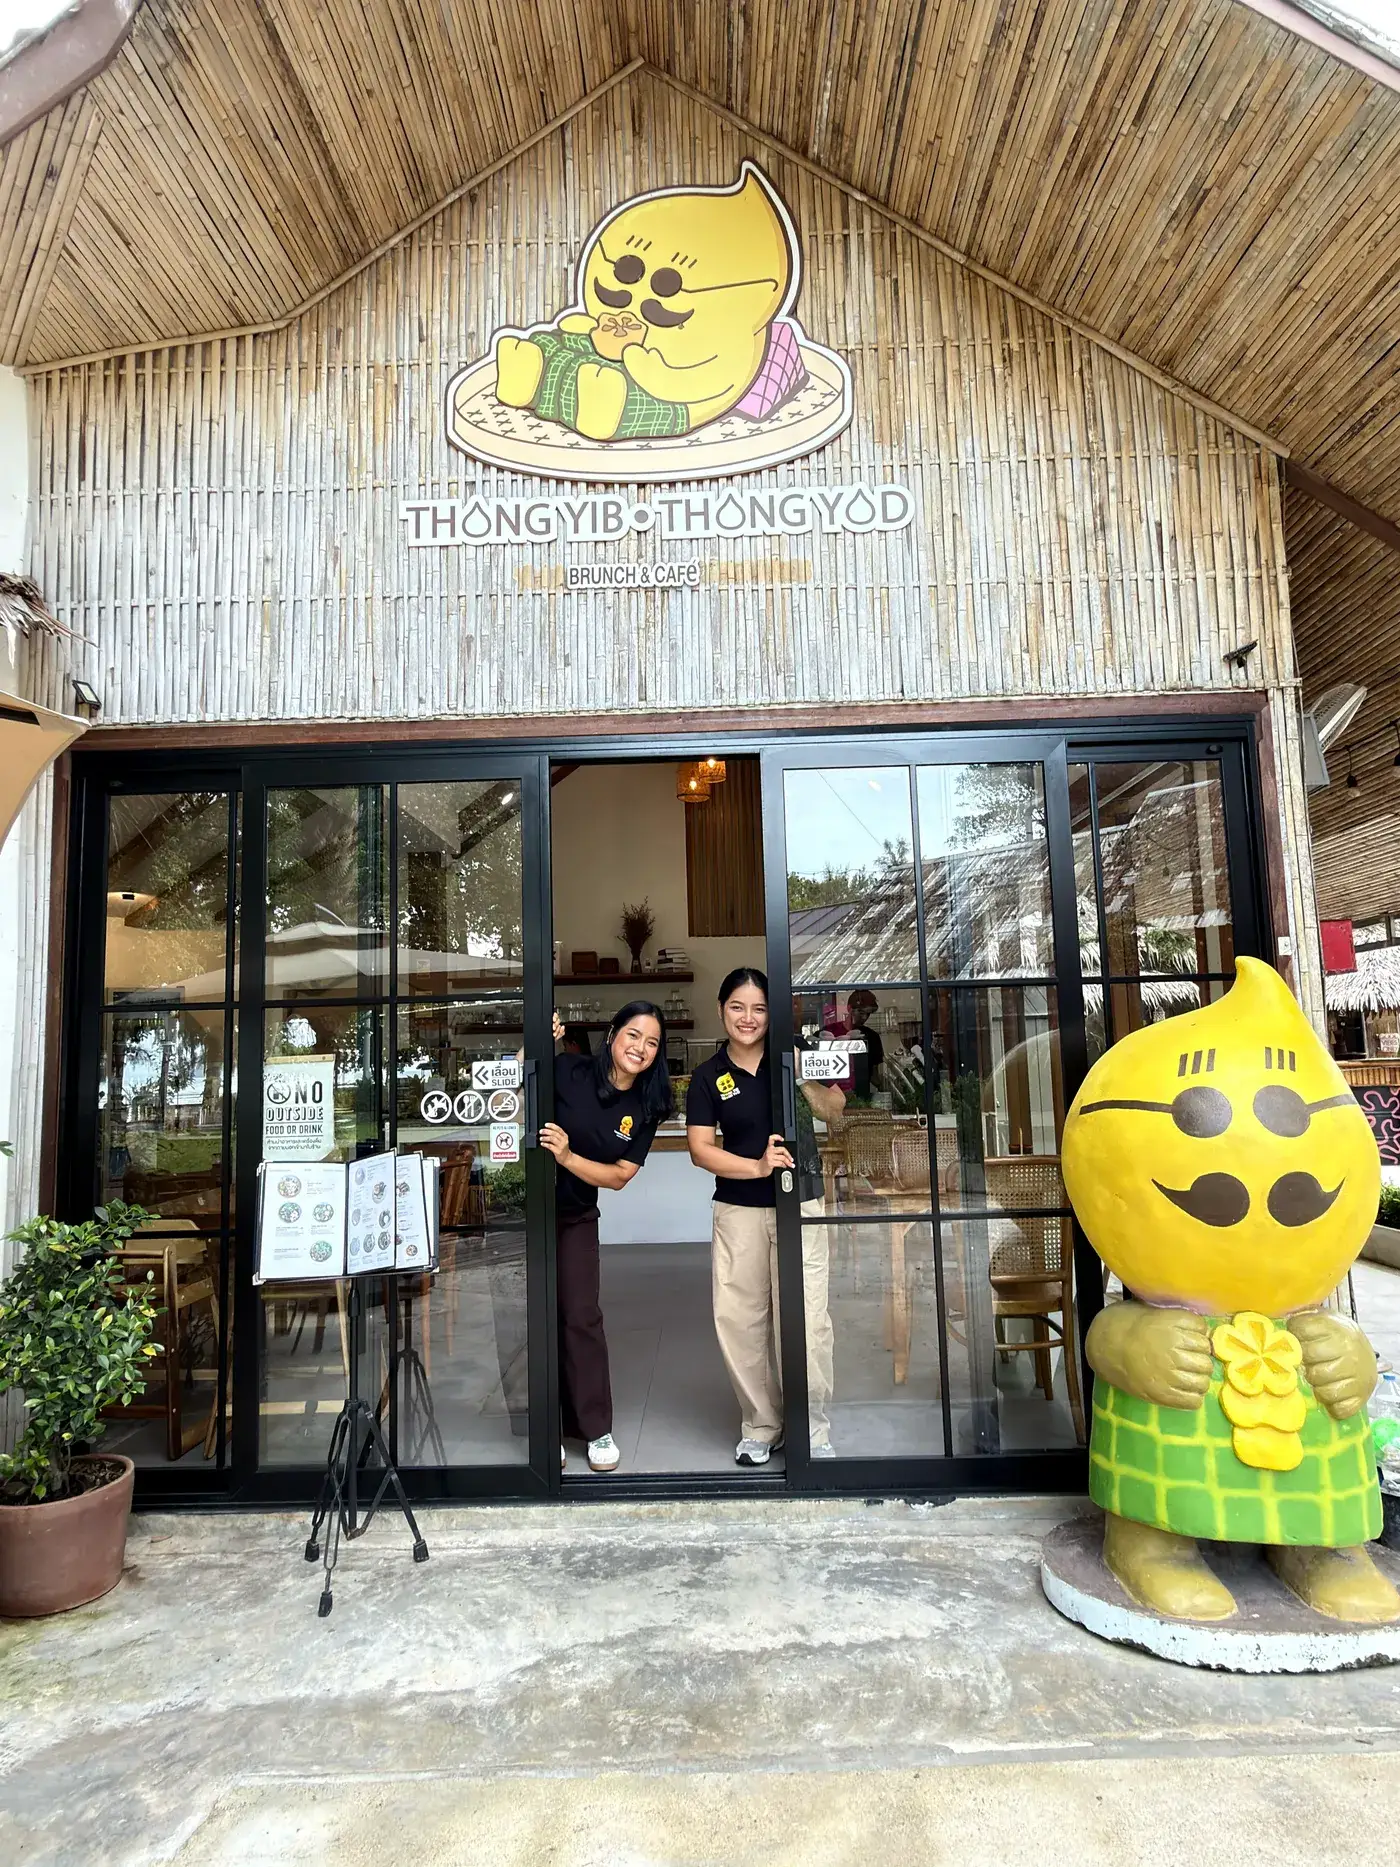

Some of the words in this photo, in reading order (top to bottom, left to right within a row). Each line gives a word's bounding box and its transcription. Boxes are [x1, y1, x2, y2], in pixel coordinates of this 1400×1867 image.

[405, 500, 551, 539] THONG
[563, 500, 624, 534] YIB
[658, 493, 806, 532] THONG
[818, 488, 909, 525] YOD
[570, 566, 636, 585] BRUNCH
[640, 566, 650, 584] &
[805, 1052, 830, 1067] เลื่อน
[491, 1062, 516, 1077] เลื่อน
[804, 1069, 830, 1077] SLIDE
[491, 1078, 517, 1087] SLIDE
[295, 1080, 323, 1104] NO
[265, 1106, 324, 1122] OUTSIDE
[265, 1125, 285, 1135] FOOD
[287, 1125, 297, 1135] OR
[299, 1124, 323, 1134] DRINK
